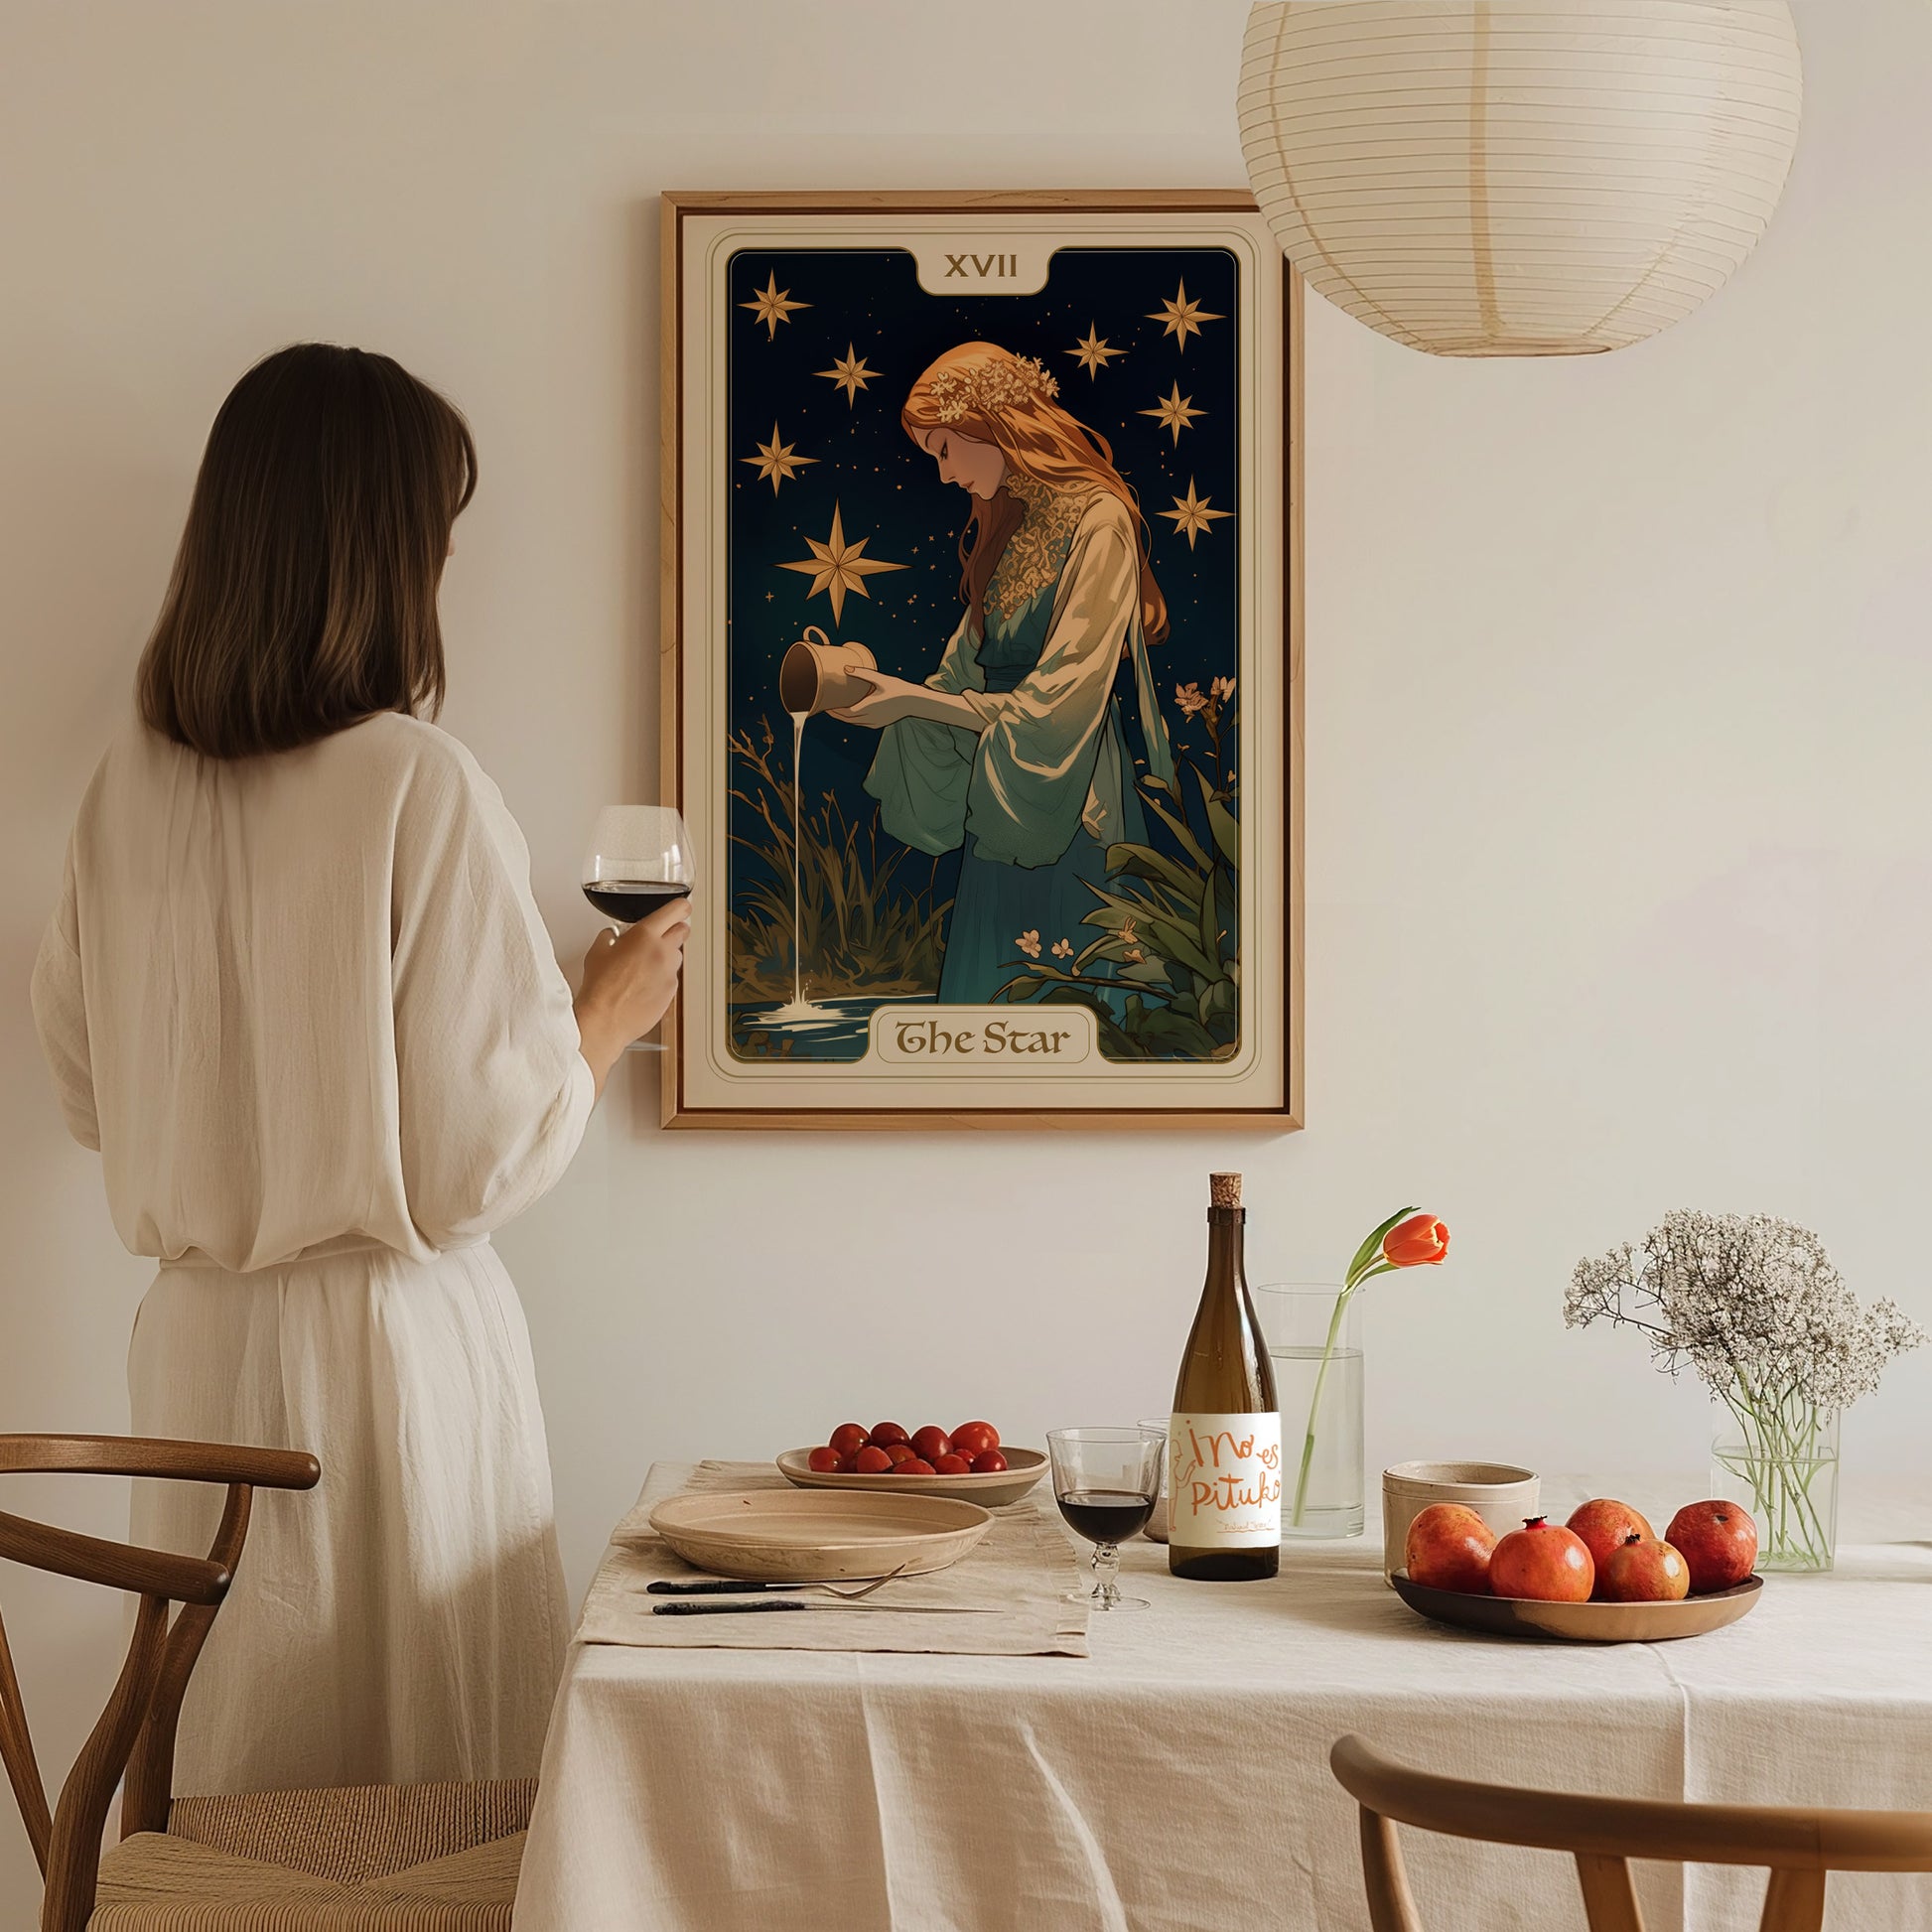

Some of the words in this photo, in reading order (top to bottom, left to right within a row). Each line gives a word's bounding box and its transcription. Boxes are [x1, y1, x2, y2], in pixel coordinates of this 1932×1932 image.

[943, 254, 1018, 278] XVII
[895, 1020, 976, 1055] The
[982, 1020, 1071, 1054] Star
